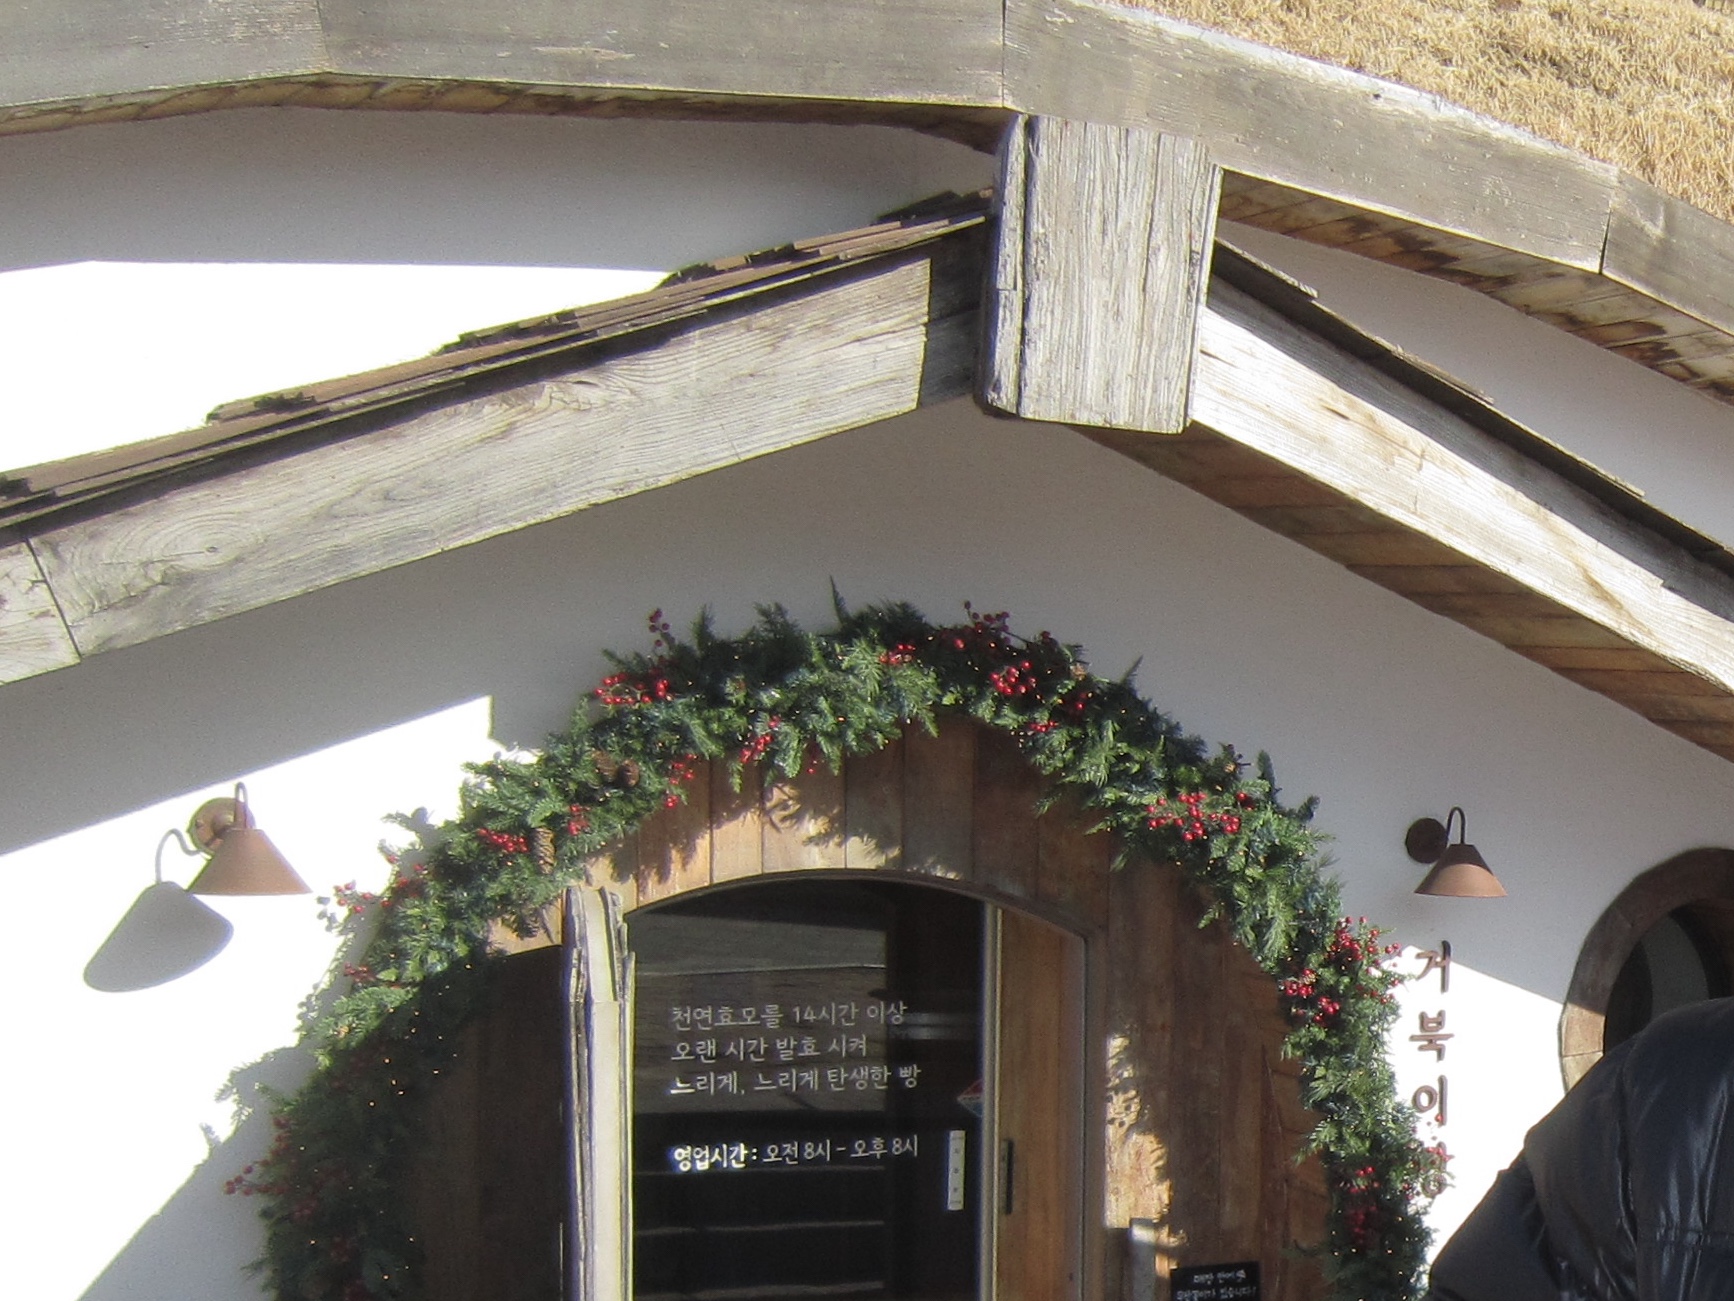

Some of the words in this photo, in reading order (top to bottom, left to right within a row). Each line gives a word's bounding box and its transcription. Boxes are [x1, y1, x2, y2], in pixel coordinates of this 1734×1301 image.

[672, 1003, 784, 1031] 천연효모를
[793, 1002, 860, 1026] 14시간
[866, 1000, 908, 1025] 이상
[671, 1038, 717, 1064] 오랜
[724, 1037, 769, 1062] 시간
[776, 1036, 821, 1061] 발효
[828, 1033, 867, 1058] 시켜
[670, 1070, 746, 1096] 느리게,
[754, 1067, 819, 1093] 느리게
[827, 1065, 892, 1091] 탄생한
[899, 1063, 922, 1089] 빵
[763, 1141, 799, 1165] 오전
[850, 1136, 888, 1160] 오후
